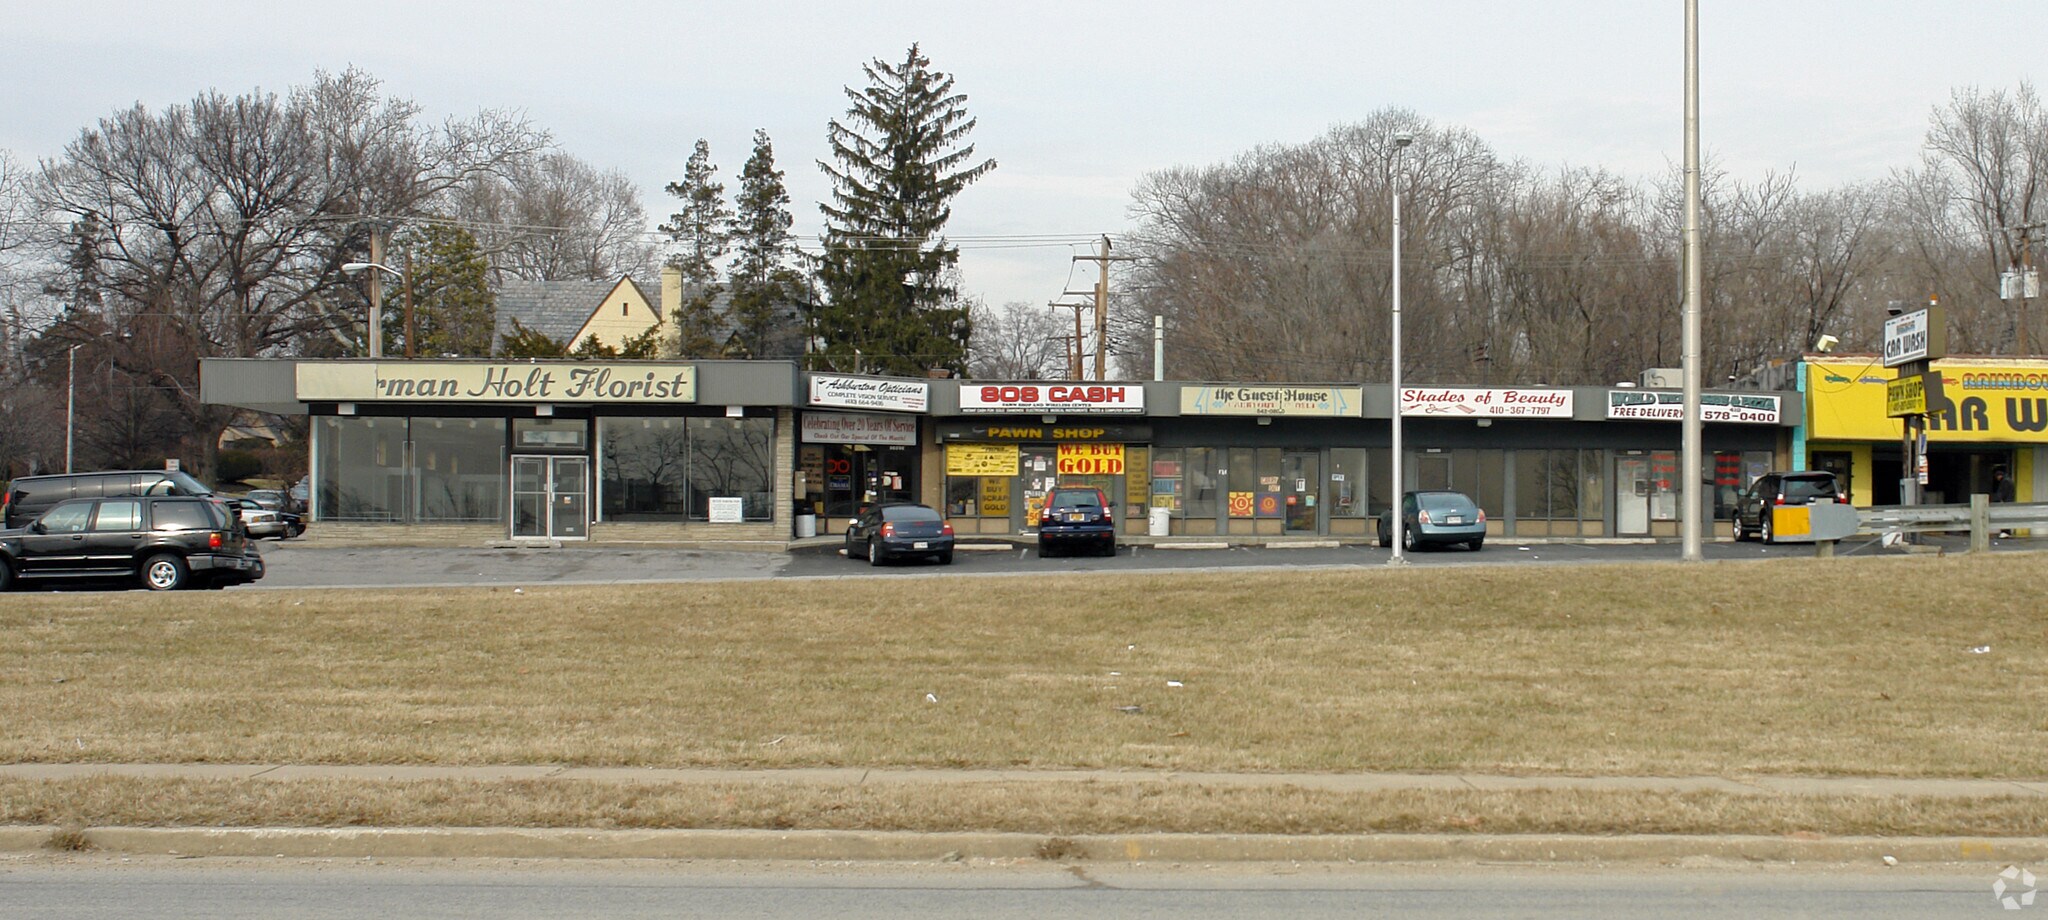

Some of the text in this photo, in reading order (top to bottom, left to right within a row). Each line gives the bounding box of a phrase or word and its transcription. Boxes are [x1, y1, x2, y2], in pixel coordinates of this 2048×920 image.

[1887, 337, 1901, 358] CAR
[1902, 330, 1925, 354] WASH
[466, 367, 555, 397] Holt
[565, 367, 688, 397] Florist
[826, 379, 923, 395] Ashburton Opticians
[827, 391, 856, 399] COMPLETE
[1048, 386, 1125, 403] CASH
[1214, 388, 1328, 403] the Guest House
[1402, 389, 1567, 406] Shades of Beauty
[1888, 381, 1922, 402] PAWN SHOP
[1611, 392, 1657, 407] WORLD
[1489, 406, 1551, 415] 410-367-7797
[1613, 407, 1637, 417] FREE
[1704, 411, 1775, 422] 578-0400
[803, 416, 840, 432] Celebrating
[842, 417, 855, 430] Over
[867, 418, 883, 431] Years
[893, 419, 915, 433] Service
[988, 427, 1105, 438] PAWN SHOP
[1059, 443, 1121, 455] WE BUY
[1059, 458, 1123, 474] GOLD
